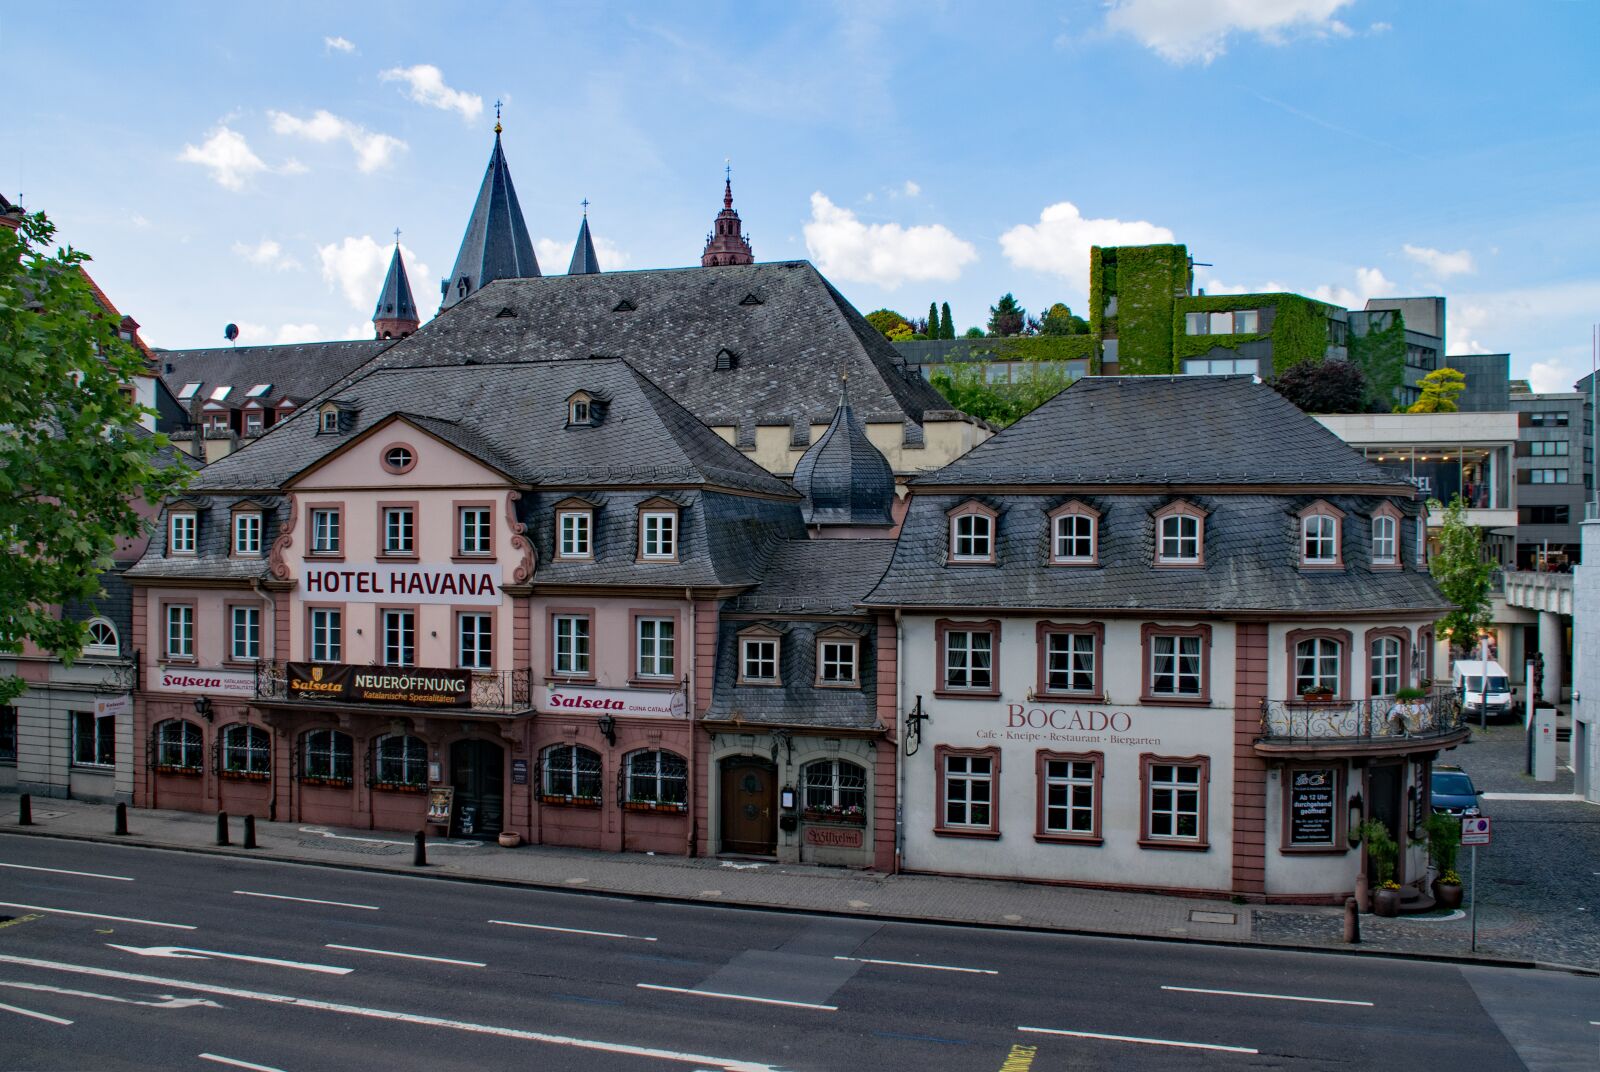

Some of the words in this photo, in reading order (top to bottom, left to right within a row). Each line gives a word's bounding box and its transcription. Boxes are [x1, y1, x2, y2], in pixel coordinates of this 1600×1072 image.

[307, 571, 384, 593] HOTEL
[390, 572, 496, 596] HAVANA
[162, 674, 221, 688] Salseta
[291, 679, 344, 692] Salseta
[355, 674, 466, 692] NEUERÖFFNUNG
[363, 690, 407, 700] Katalanische
[408, 692, 456, 703] Spezialitäten
[550, 694, 626, 710] Salseta
[1006, 704, 1132, 732] BOCADO
[976, 729, 998, 739] Cafe
[1006, 731, 1041, 743] Kneipe
[1050, 732, 1101, 743] Restaurant
[1110, 735, 1161, 746] Biergarten
[808, 829, 858, 845] Wilhelmi
